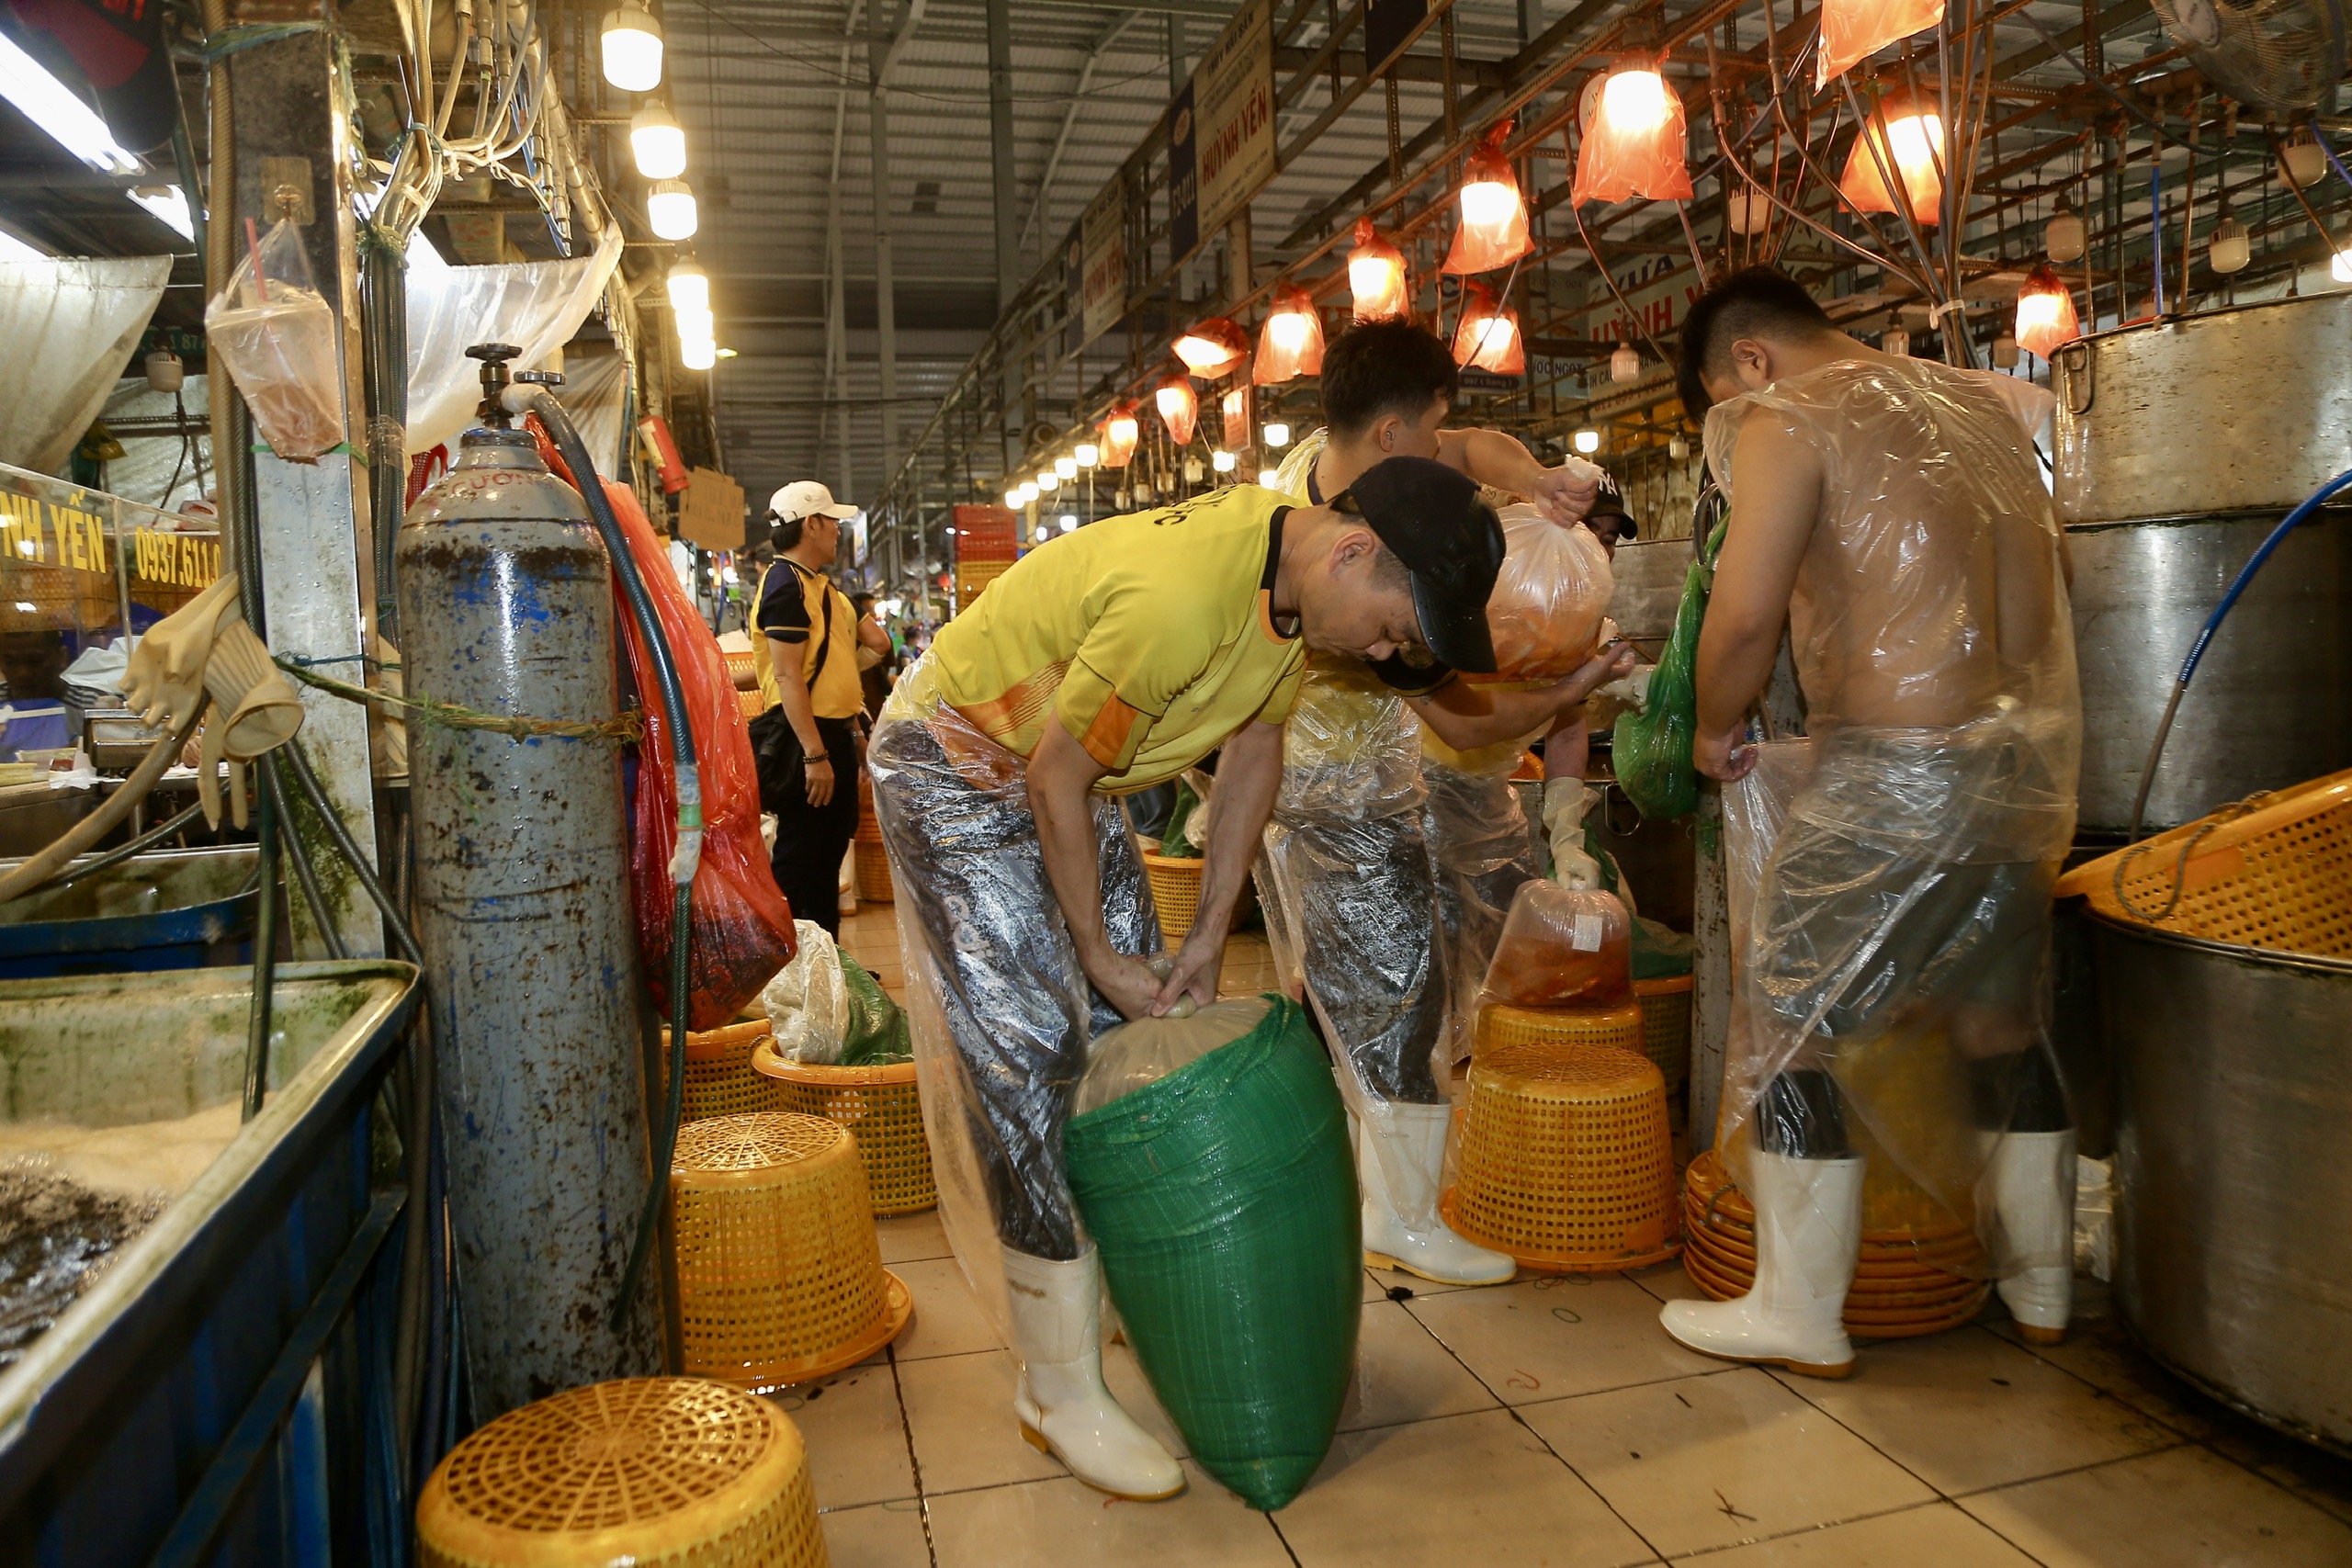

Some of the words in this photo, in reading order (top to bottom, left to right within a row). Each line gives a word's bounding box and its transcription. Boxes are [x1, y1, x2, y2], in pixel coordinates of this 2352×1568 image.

[1203, 126, 1238, 187] HUỲNH
[1242, 79, 1268, 143] YẾN
[49, 489, 107, 574] YẾN
